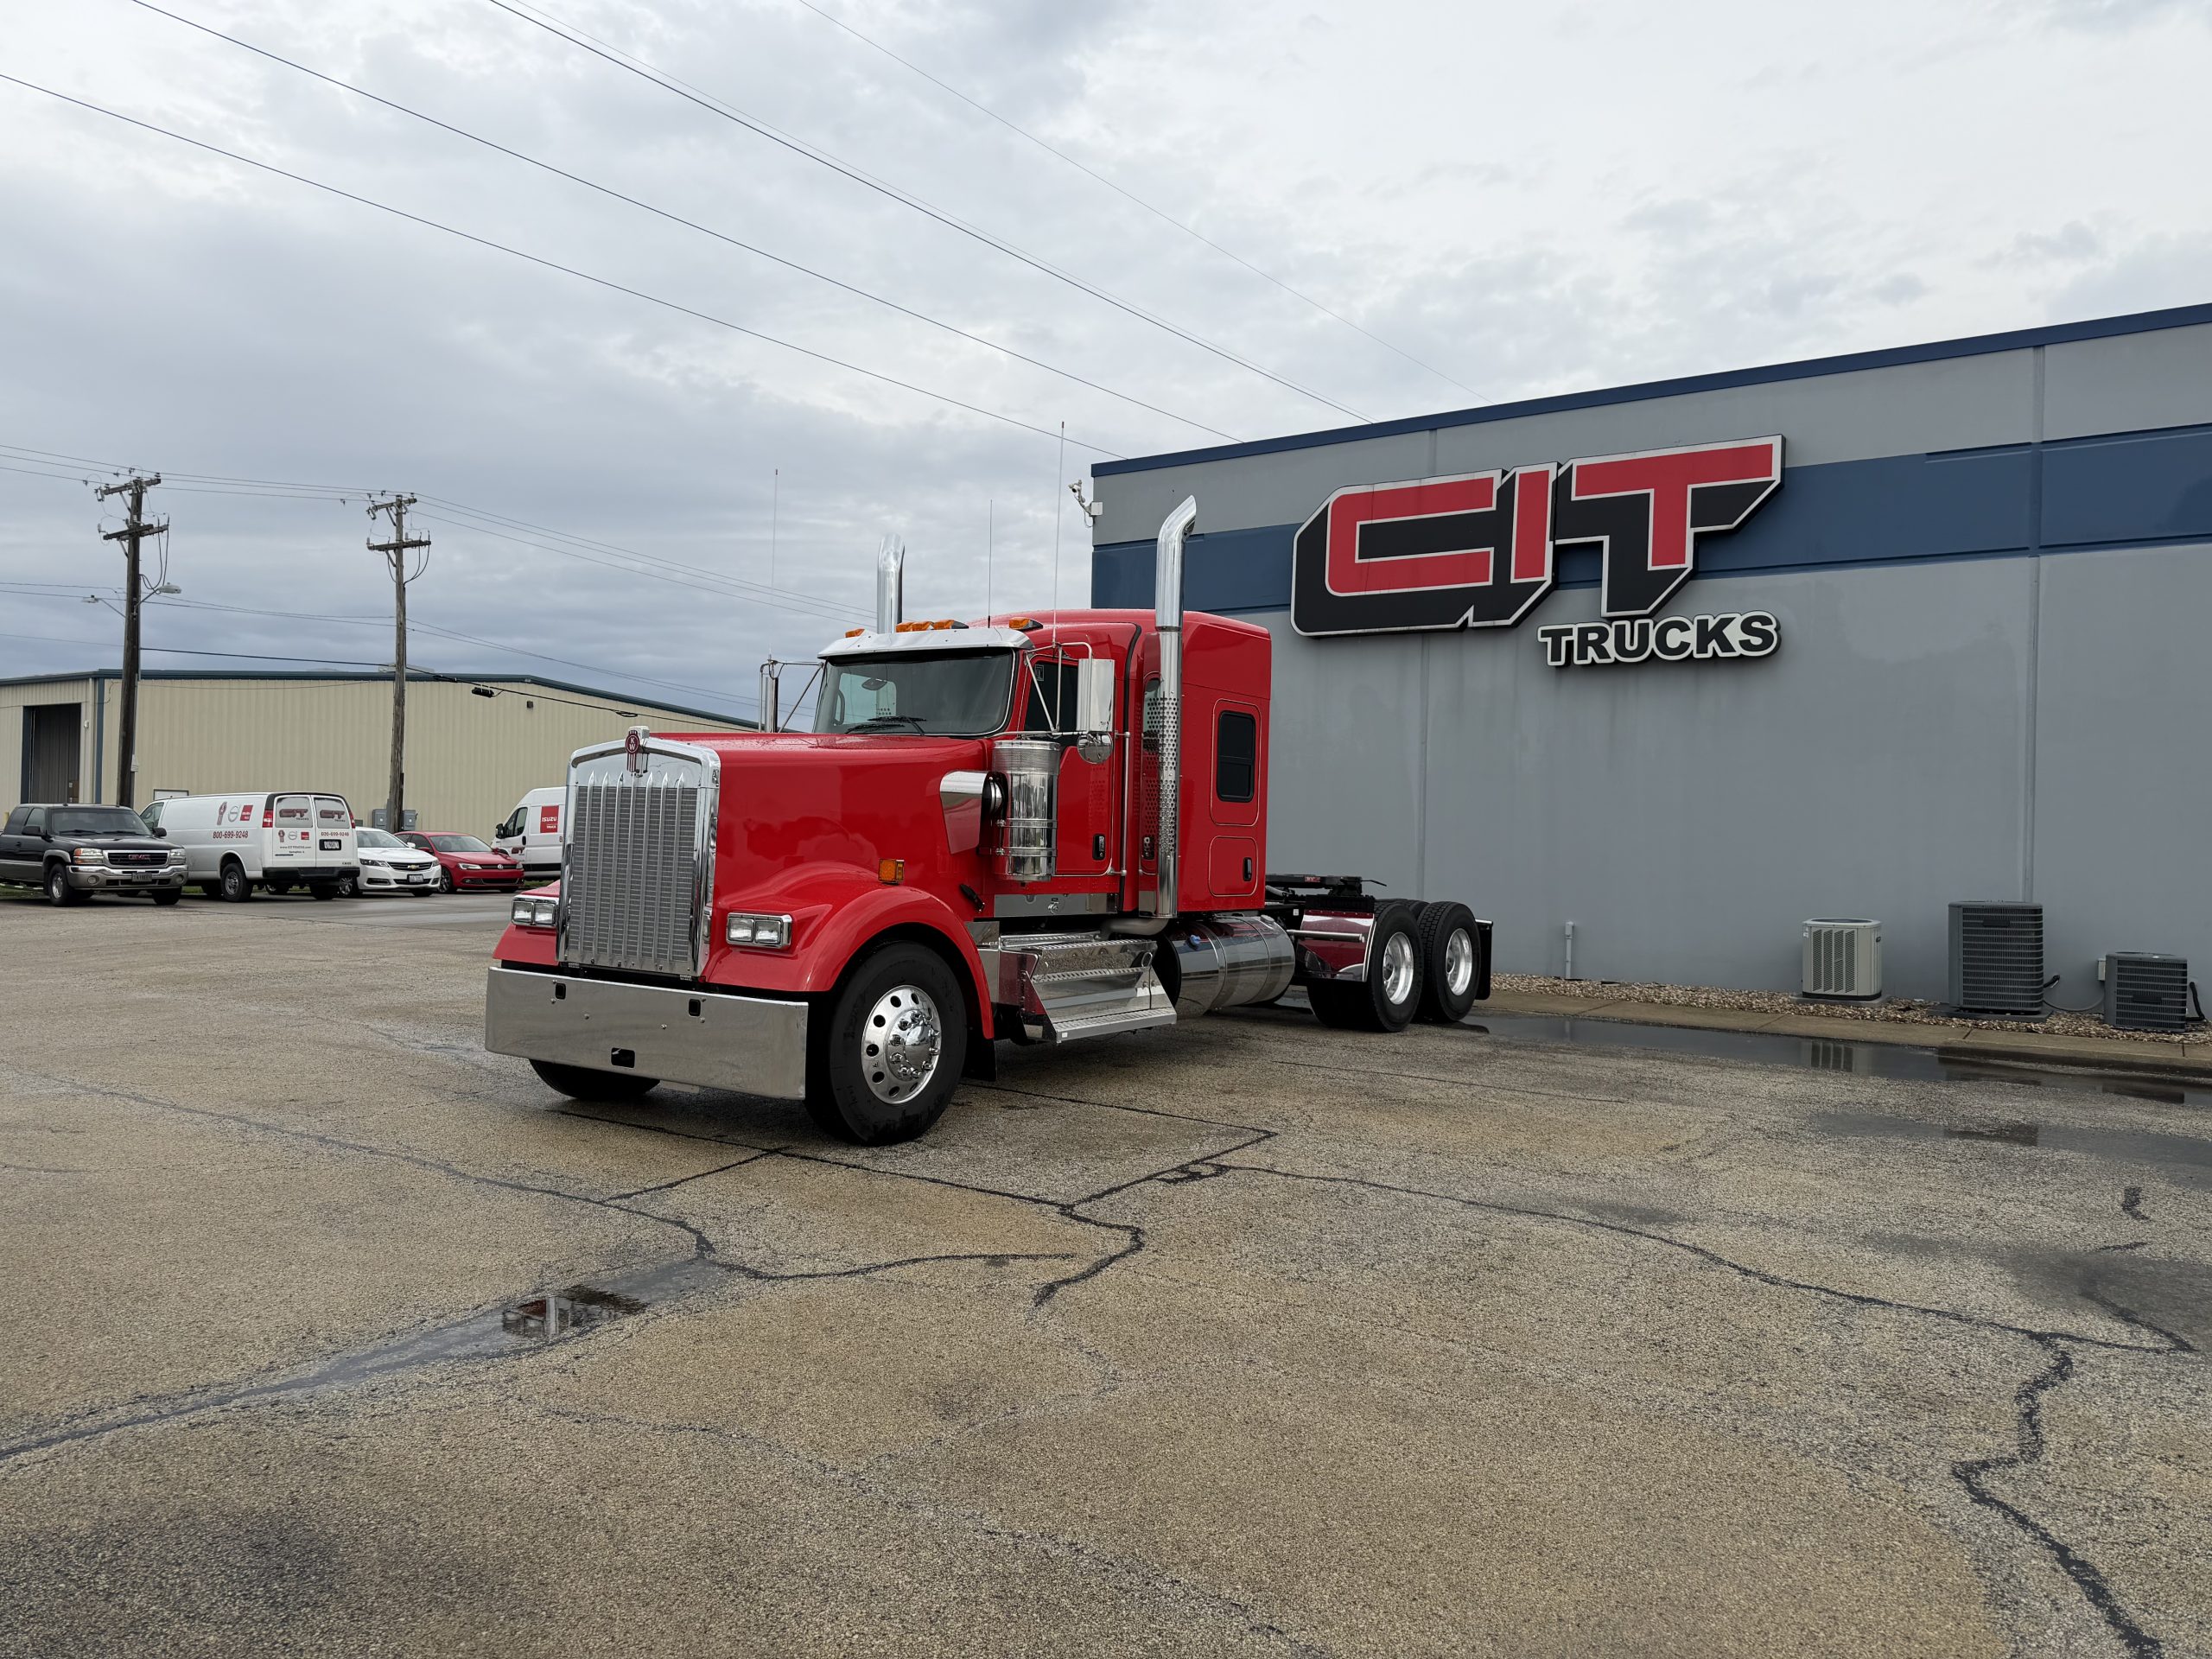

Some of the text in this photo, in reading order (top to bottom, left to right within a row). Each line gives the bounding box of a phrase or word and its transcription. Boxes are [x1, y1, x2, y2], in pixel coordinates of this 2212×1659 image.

[1291, 434, 1784, 638] CIT
[1537, 610, 1783, 667] TRUCKS
[213, 830, 249, 839] 800-699-9248
